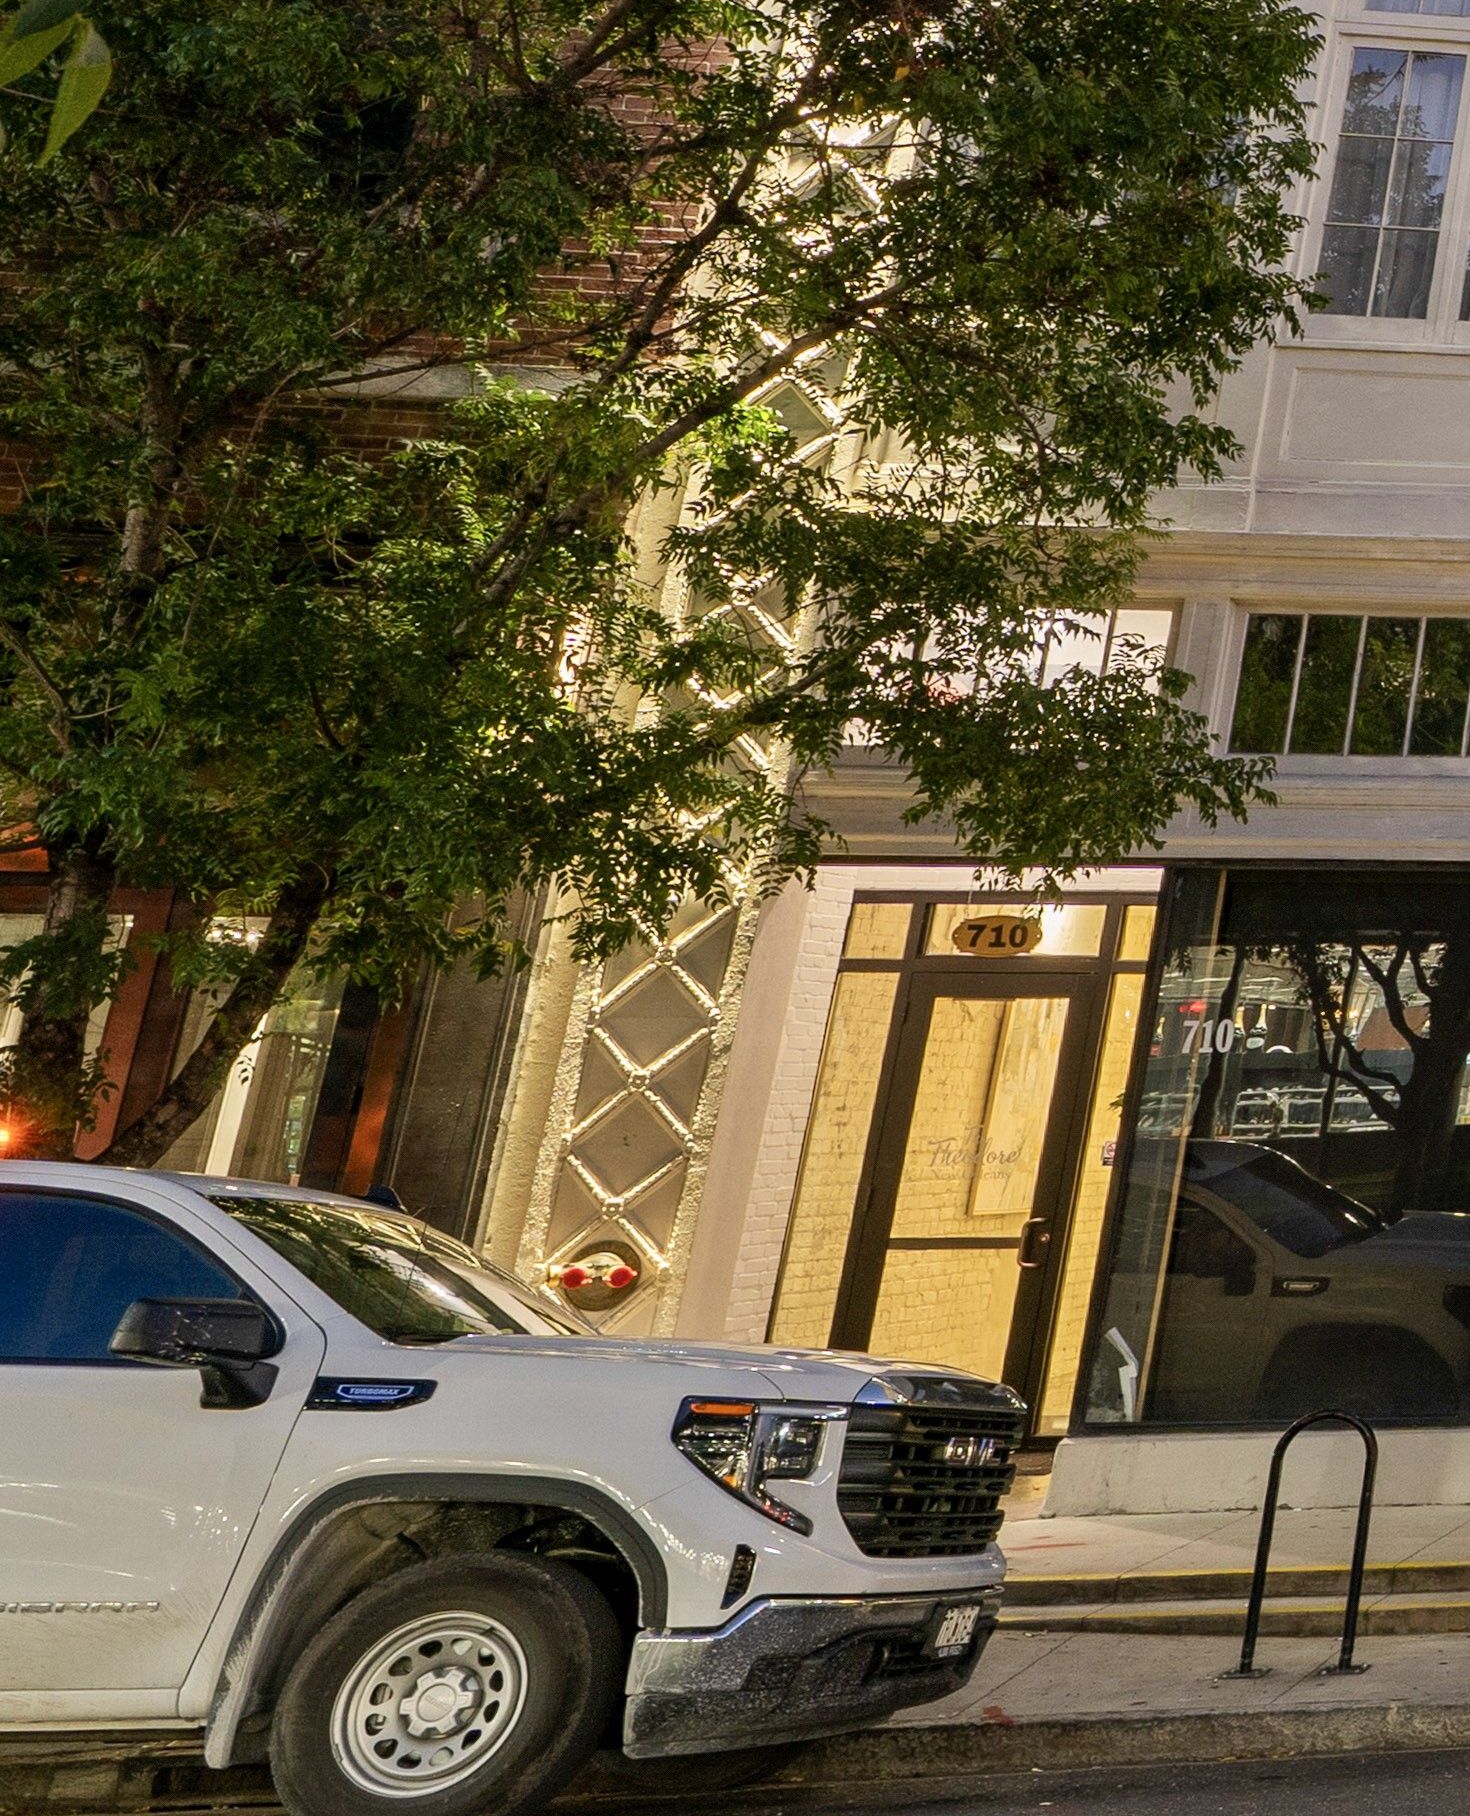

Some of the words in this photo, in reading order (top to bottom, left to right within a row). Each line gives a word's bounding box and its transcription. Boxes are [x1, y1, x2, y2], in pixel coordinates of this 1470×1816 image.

[967, 924, 1028, 948] 710
[1181, 1018, 1235, 1054] 710
[349, 1387, 400, 1396] TURBOMAX
[0, 1601, 160, 1614] IERRA
